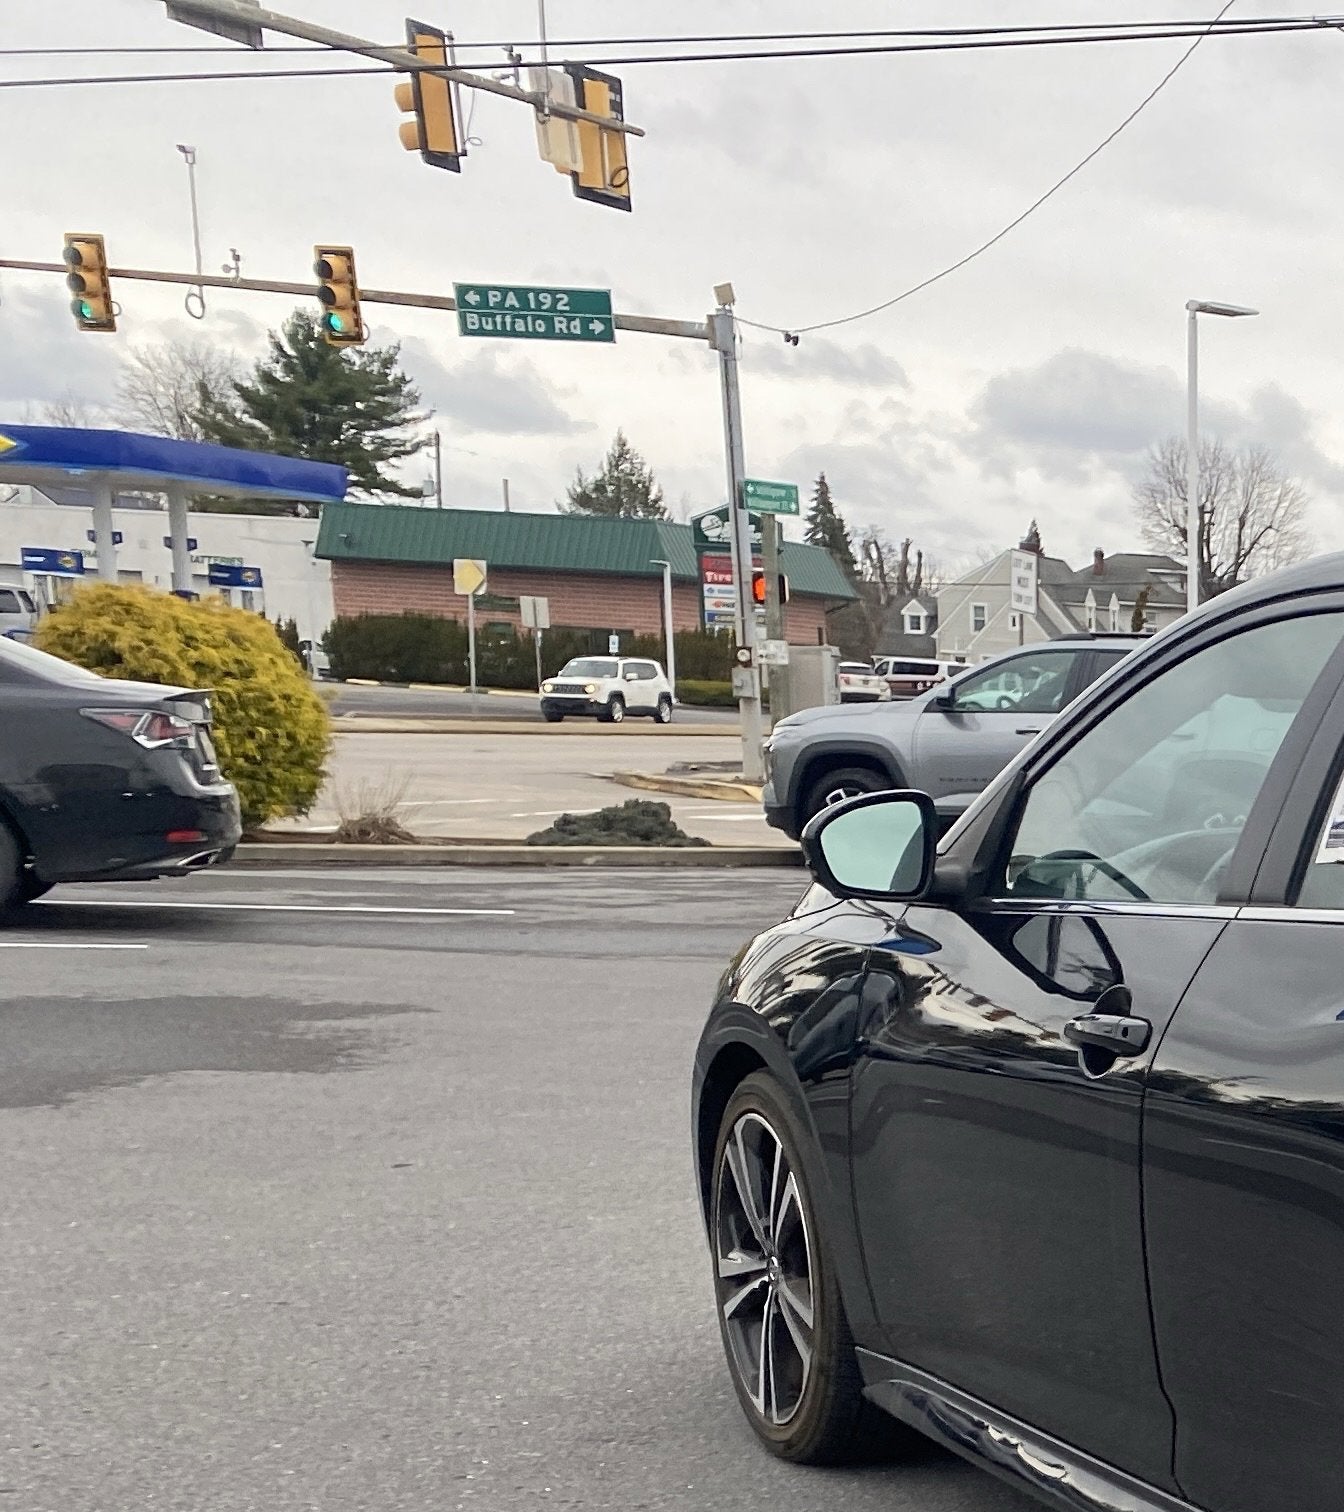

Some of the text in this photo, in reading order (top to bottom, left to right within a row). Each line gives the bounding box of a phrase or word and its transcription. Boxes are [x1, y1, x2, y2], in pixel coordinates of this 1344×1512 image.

[487, 290, 571, 312] PA 192
[466, 312, 581, 335] Buffalo Rd
